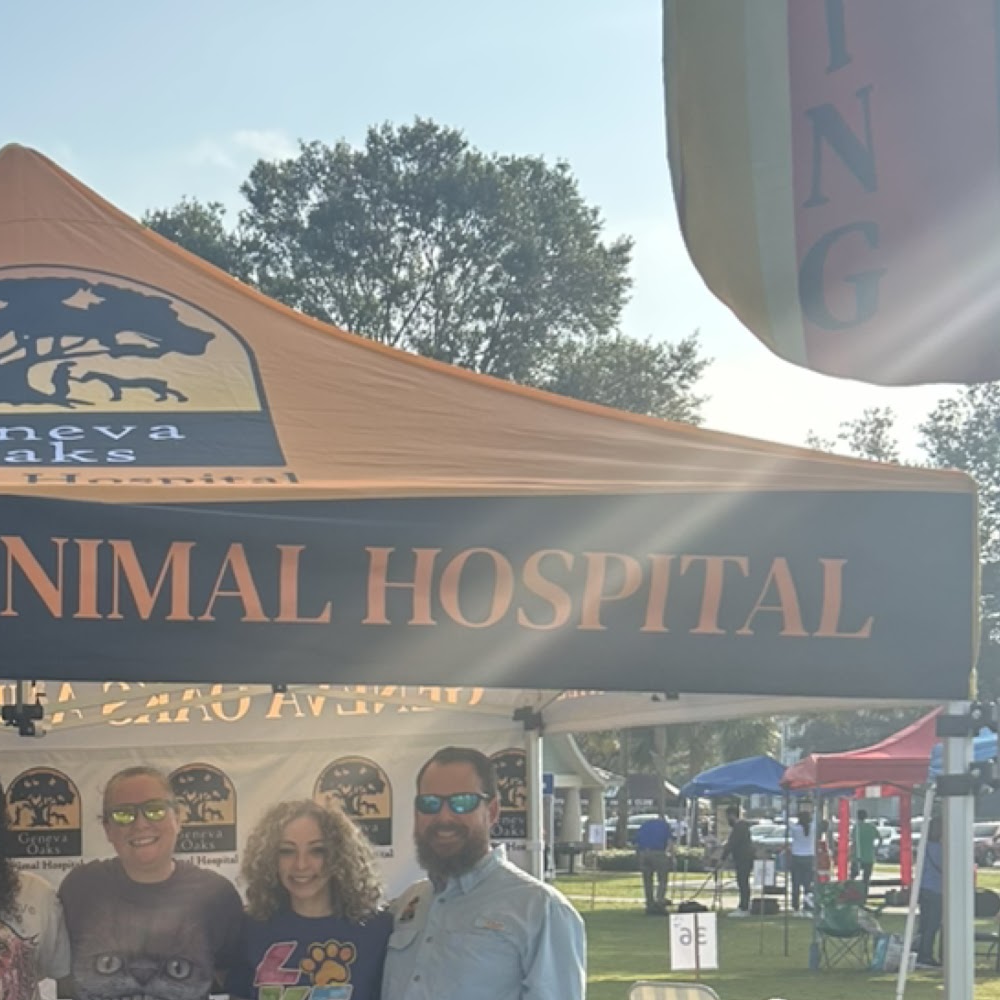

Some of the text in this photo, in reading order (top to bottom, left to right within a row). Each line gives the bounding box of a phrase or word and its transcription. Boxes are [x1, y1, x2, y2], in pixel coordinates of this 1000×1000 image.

[22, 471, 299, 486] Hospital
[364, 546, 875, 641] HOSPITAL
[17, 833, 68, 845] Geneva
[180, 839, 216, 850] Oaks
[26, 844, 61, 855] Oaks
[197, 854, 239, 868] Hospital
